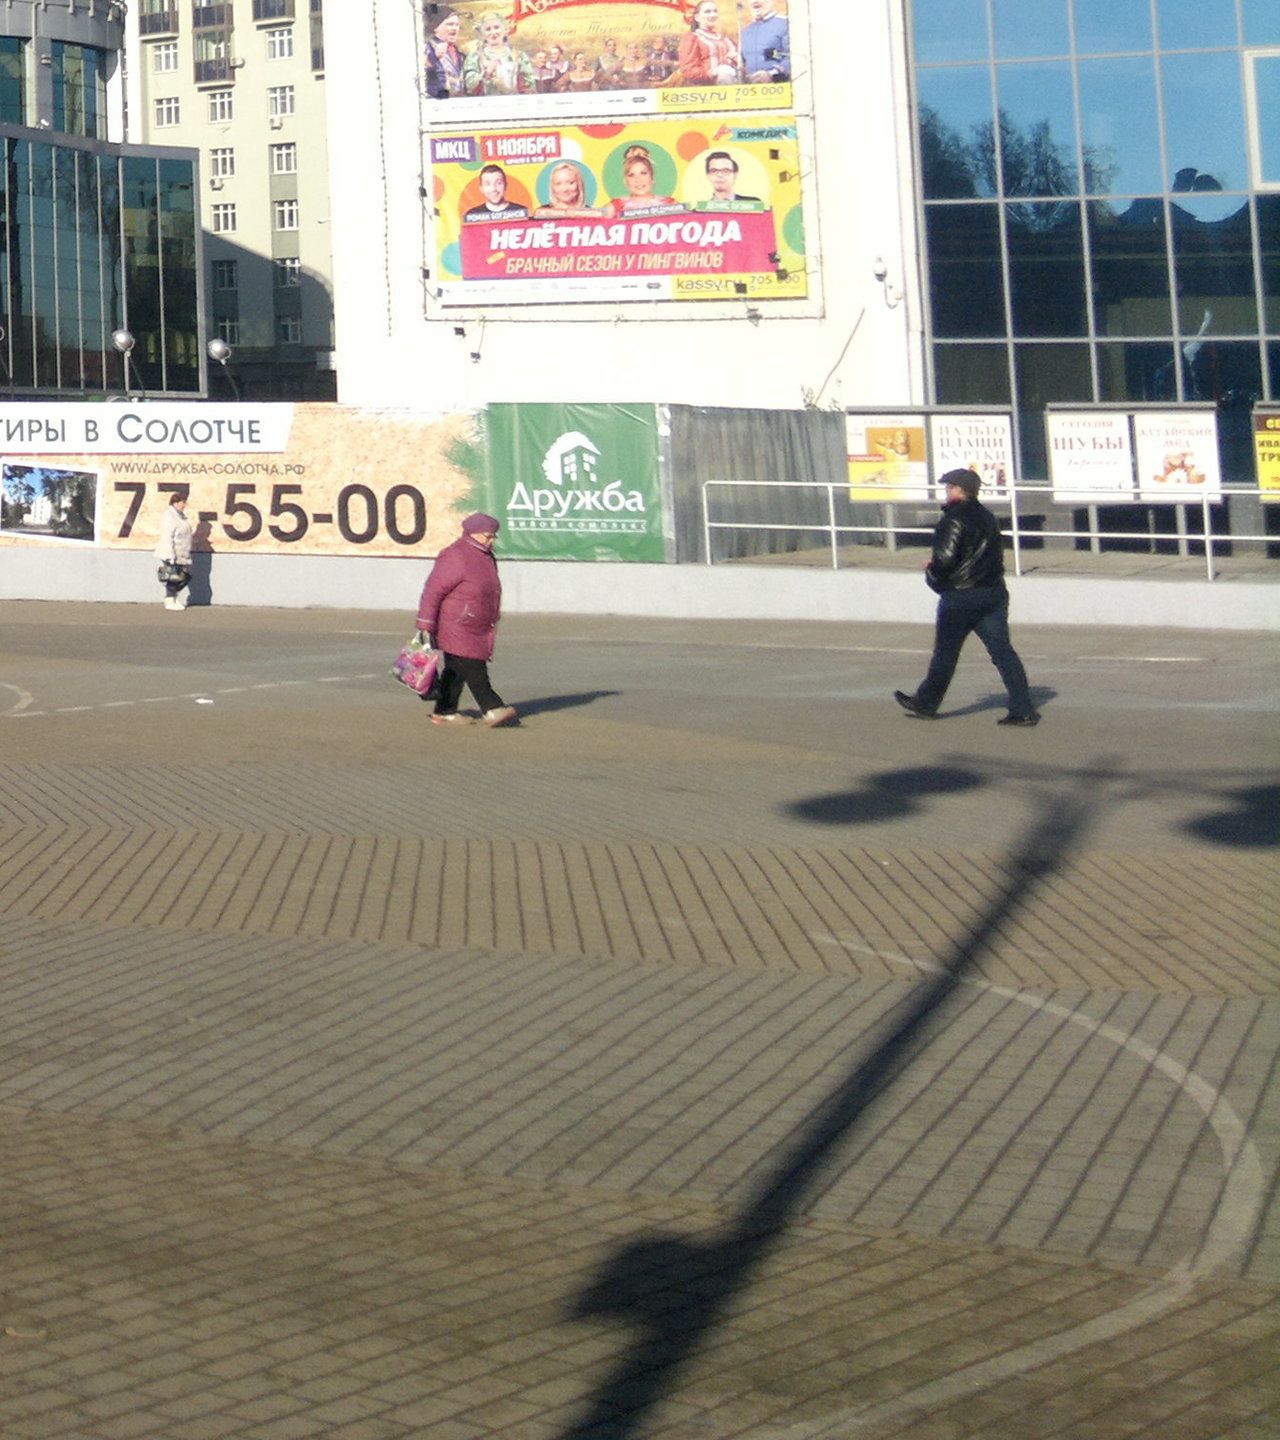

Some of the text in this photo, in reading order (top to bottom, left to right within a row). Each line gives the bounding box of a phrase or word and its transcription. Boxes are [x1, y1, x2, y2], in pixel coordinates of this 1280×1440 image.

[661, 91, 728, 104] kassy.ru
[435, 141, 470, 160] МКЦ
[486, 136, 557, 157] 1 НОЯБРЯ
[490, 220, 742, 250] НЕЛЁТНАЯ ПОГОДА
[506, 251, 724, 274] БРАЧНЫЙ СЕЗОН У ПИНГВИНОВ
[1054, 437, 1124, 450] ШУБЫ
[506, 479, 646, 518] Дружба
